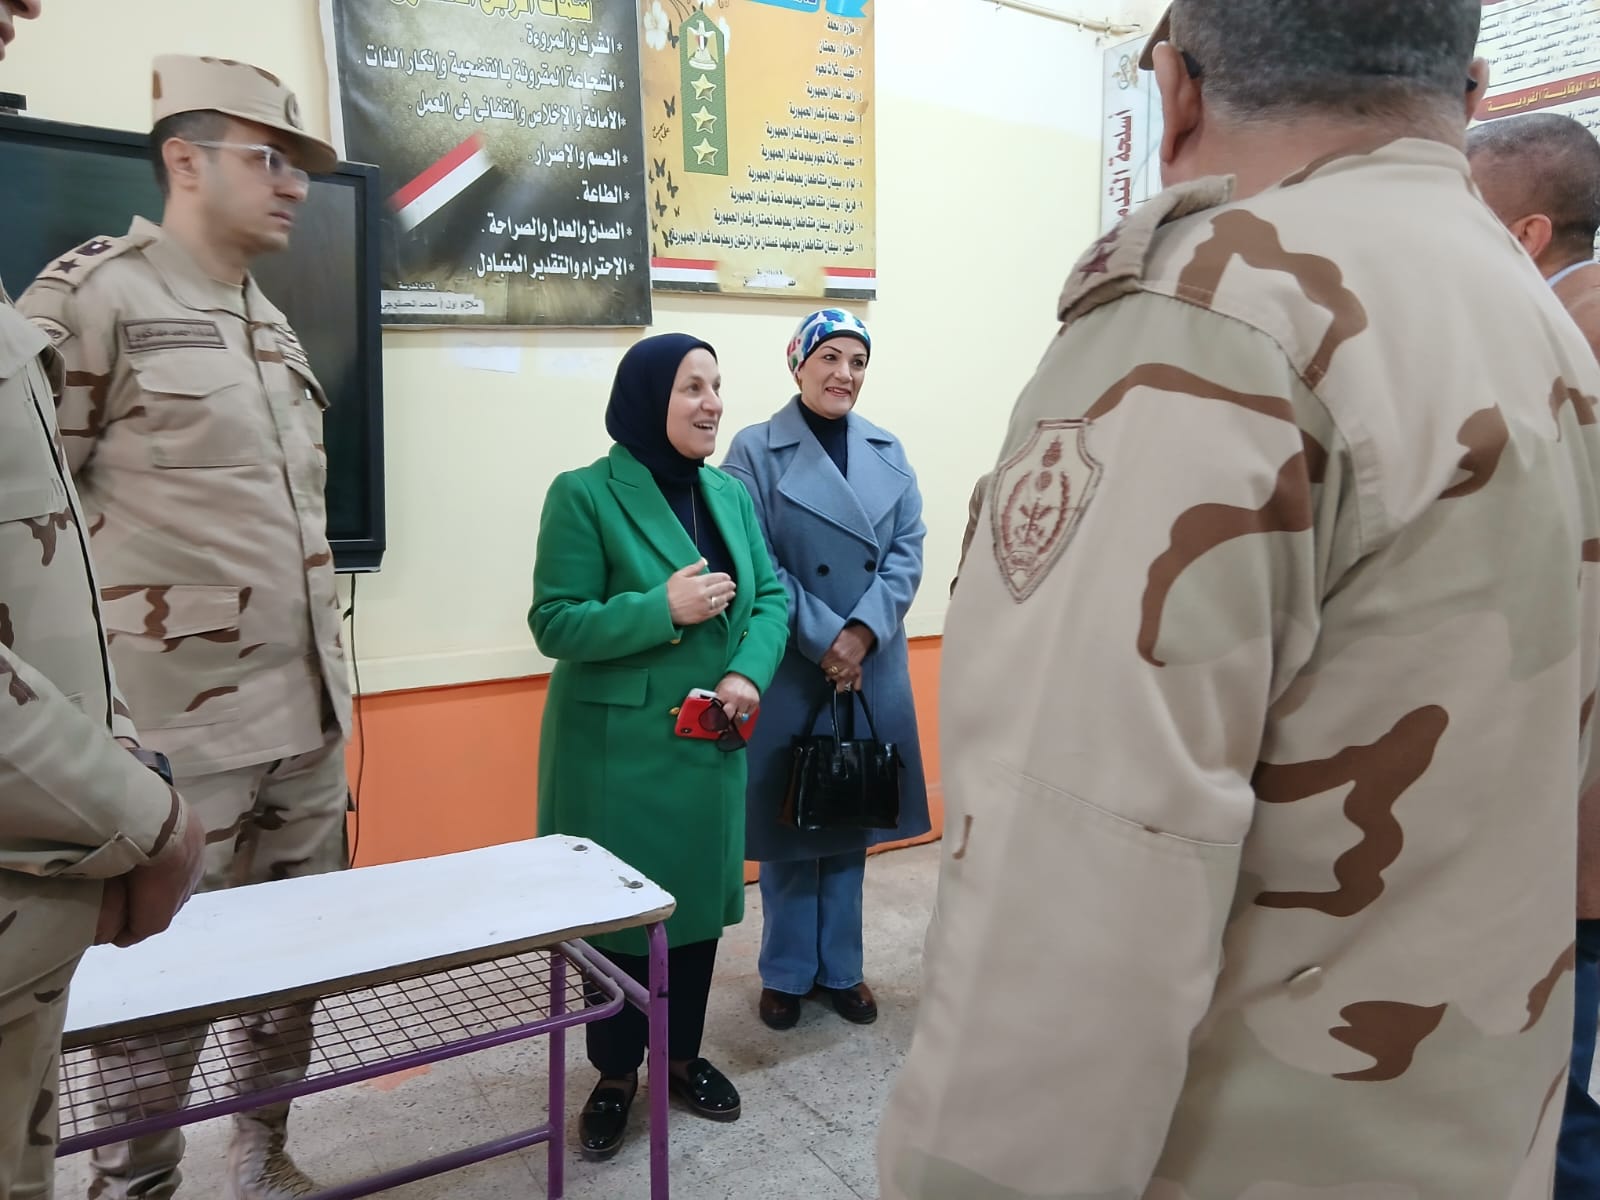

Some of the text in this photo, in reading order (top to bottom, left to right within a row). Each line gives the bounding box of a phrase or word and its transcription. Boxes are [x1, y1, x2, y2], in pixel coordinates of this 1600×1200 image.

[525, 23, 615, 57] الشرف والمروءة
[365, 44, 404, 69] الذات
[448, 50, 512, 88] بالتضحية
[512, 59, 564, 89] المقرونة
[565, 65, 617, 95] الشجاعة
[416, 90, 451, 117] العمل
[527, 102, 581, 131] والإخلاص
[582, 105, 621, 130] الأمانة
[535, 142, 585, 169] والإصرار
[582, 180, 622, 203] الطاعة
[1108, 169, 1130, 217] التدم
[487, 212, 625, 244] الصدق والعدل والصراحة
[476, 252, 628, 281] الإحترام والتقدير المتبادل
